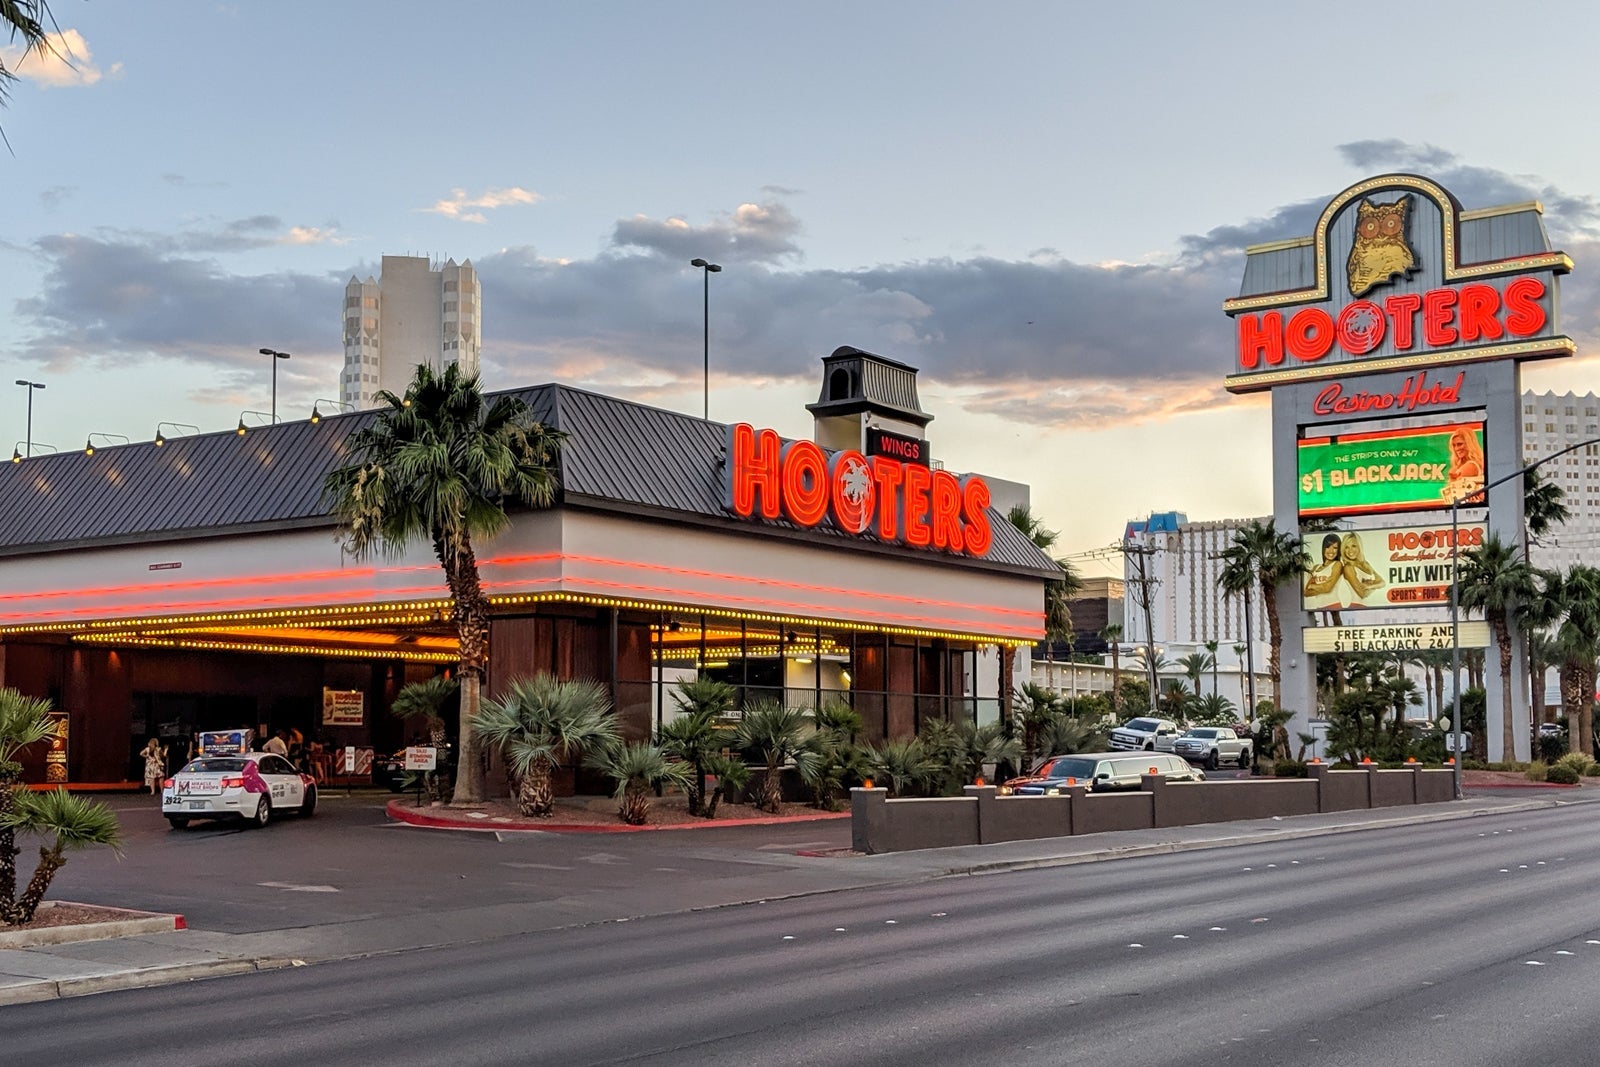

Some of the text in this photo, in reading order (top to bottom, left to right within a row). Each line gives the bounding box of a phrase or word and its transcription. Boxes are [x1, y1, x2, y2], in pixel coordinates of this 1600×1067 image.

[1239, 277, 1547, 368] HOOTERS
[1313, 370, 1465, 416] Casino Hotel
[881, 435, 920, 459] WINGS
[1334, 449, 1419, 464] THE STRIP'S ONLY 24/7
[1302, 463, 1447, 493] $1 BLACKJACK
[732, 422, 992, 557] HOOTERS
[1389, 566, 1421, 583] PLAY
[1391, 588, 1440, 600] SPORTS FOOD
[1337, 626, 1454, 640] FREE PARKING AND
[1334, 638, 1454, 652] $1 BLACKJACK 24/
